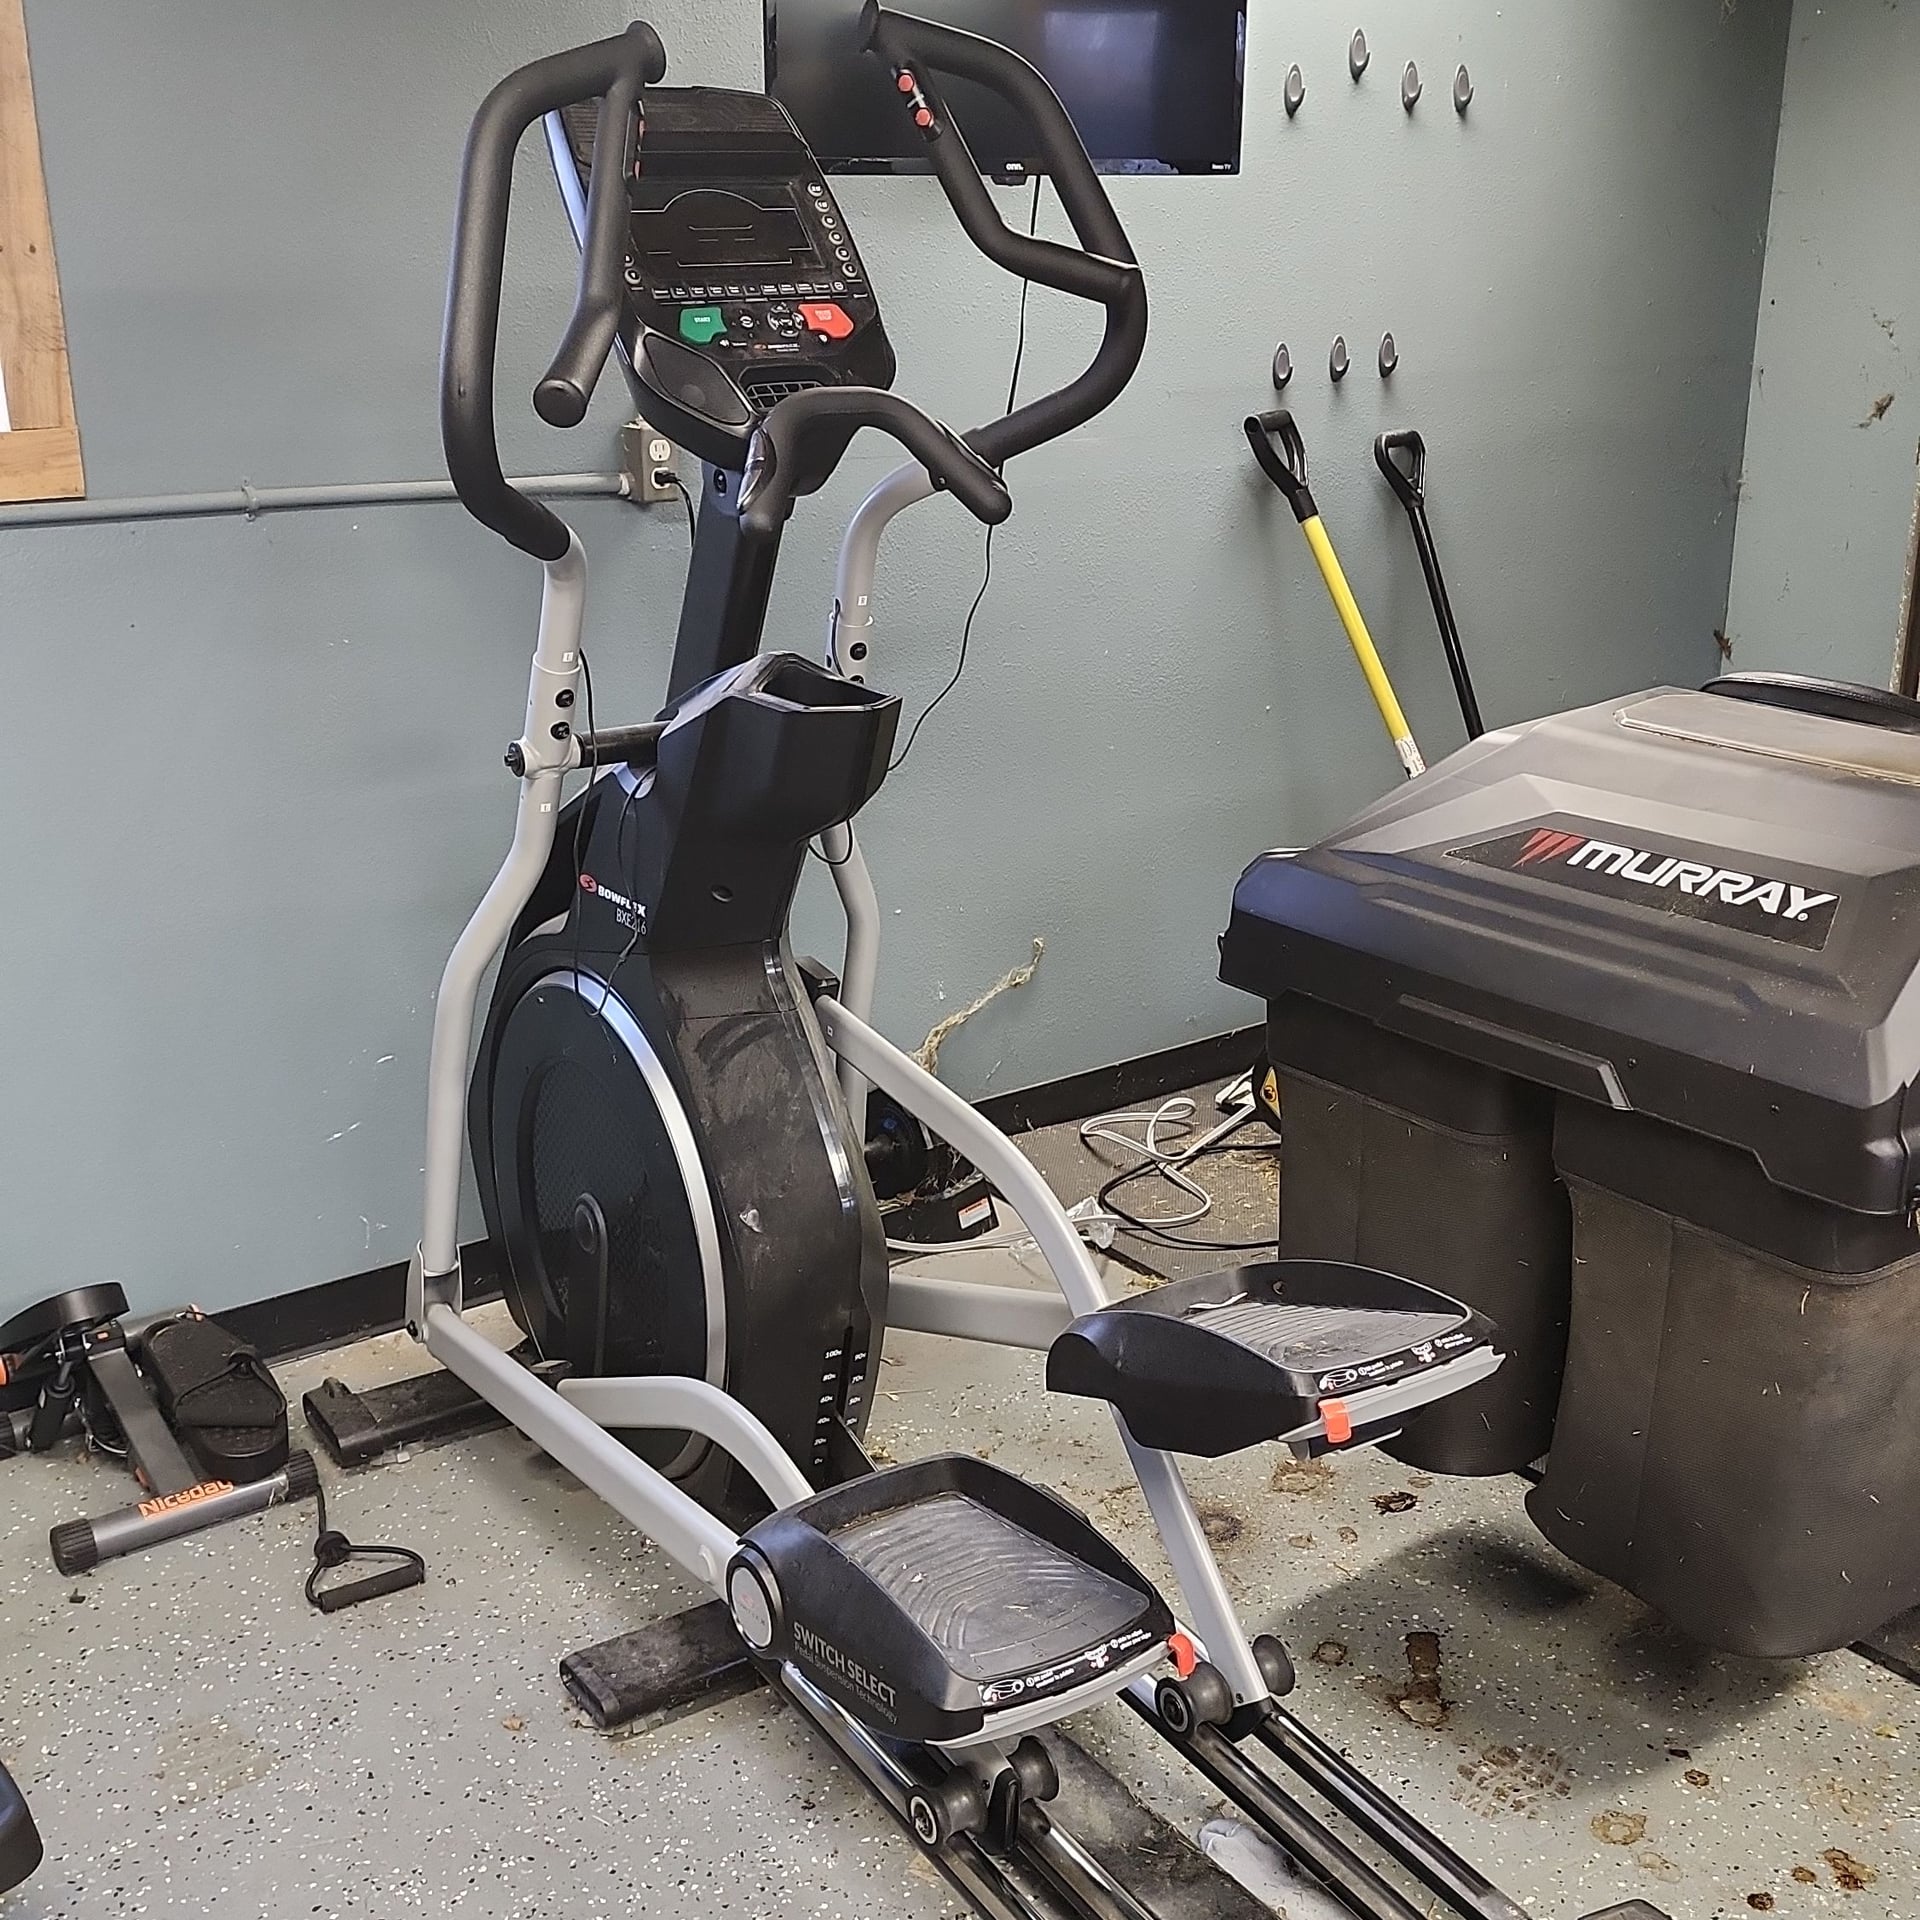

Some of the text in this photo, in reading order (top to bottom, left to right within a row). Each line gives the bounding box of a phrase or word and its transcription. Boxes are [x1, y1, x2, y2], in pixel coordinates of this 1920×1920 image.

[1566, 838, 1839, 920] MURRAY
[794, 1621, 896, 1708] SWITCH SELECT
